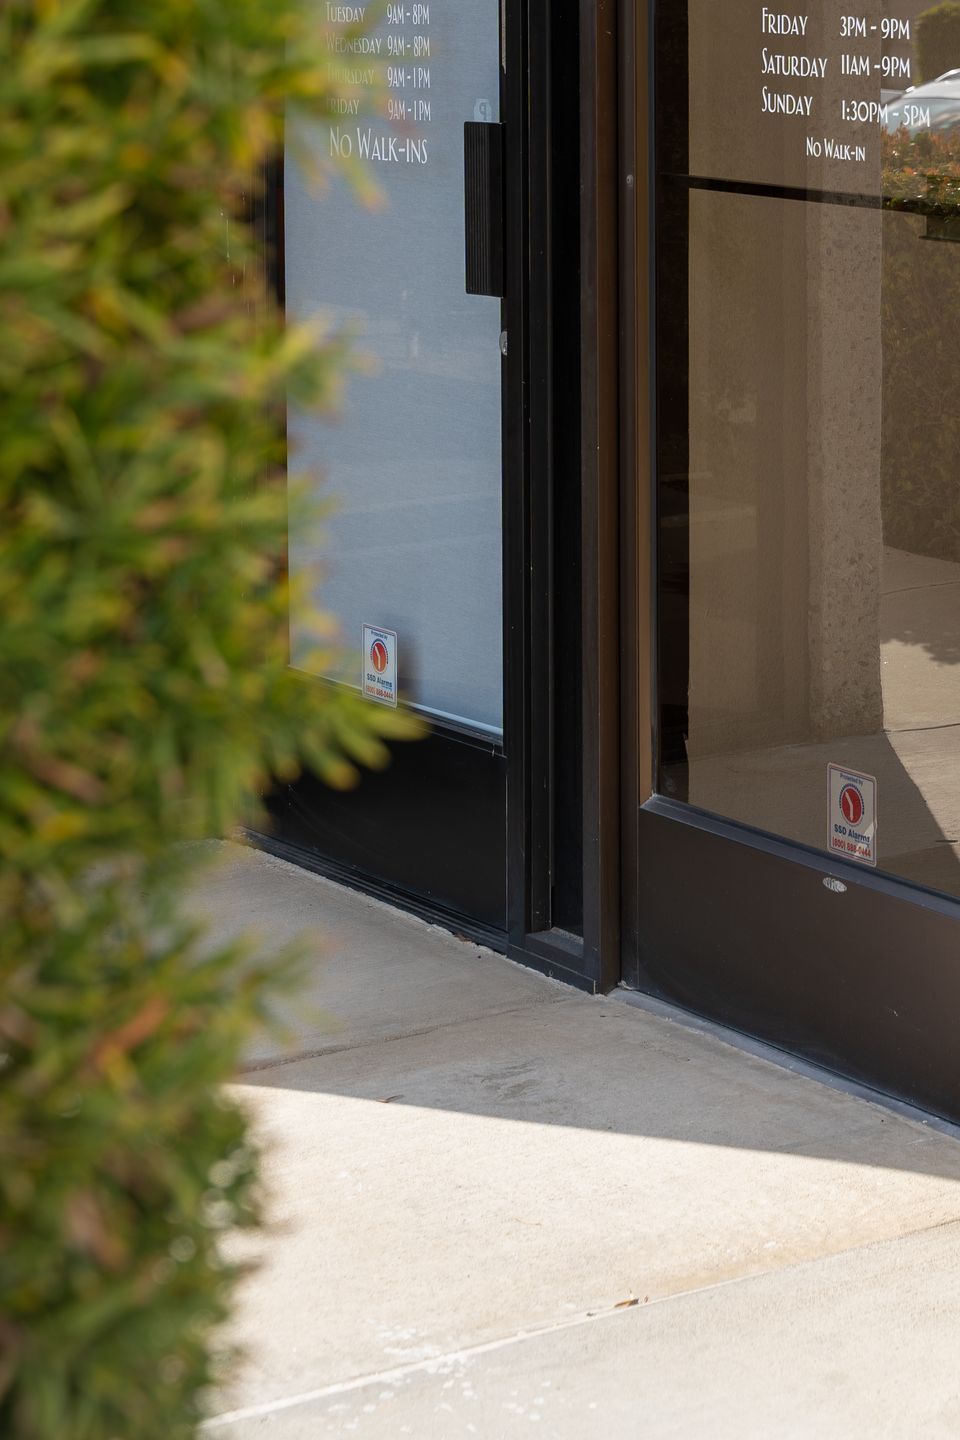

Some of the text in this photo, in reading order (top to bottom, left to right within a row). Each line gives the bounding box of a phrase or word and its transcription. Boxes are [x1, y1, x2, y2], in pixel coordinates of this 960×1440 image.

[326, 1, 366, 23] TUESDAY
[386, 3, 405, 25] 9AM
[412, 4, 431, 25] 8PM
[761, 7, 808, 36] FRIDAY
[839, 16, 867, 37] 3PM
[880, 18, 910, 40] 9PM
[387, 35, 405, 56] 9AM
[413, 35, 431, 57] 8PM
[761, 47, 828, 78] SATURDAY
[841, 54, 871, 76] 11AM
[387, 66, 405, 88] 9AM
[387, 99, 406, 121] 9AM
[761, 86, 813, 116] SUNDAY
[841, 99, 888, 123] 1:30PM
[903, 105, 931, 127] 5PM
[330, 126, 428, 164] NO WALK-INS
[806, 136, 866, 161] NO WALK-IN
